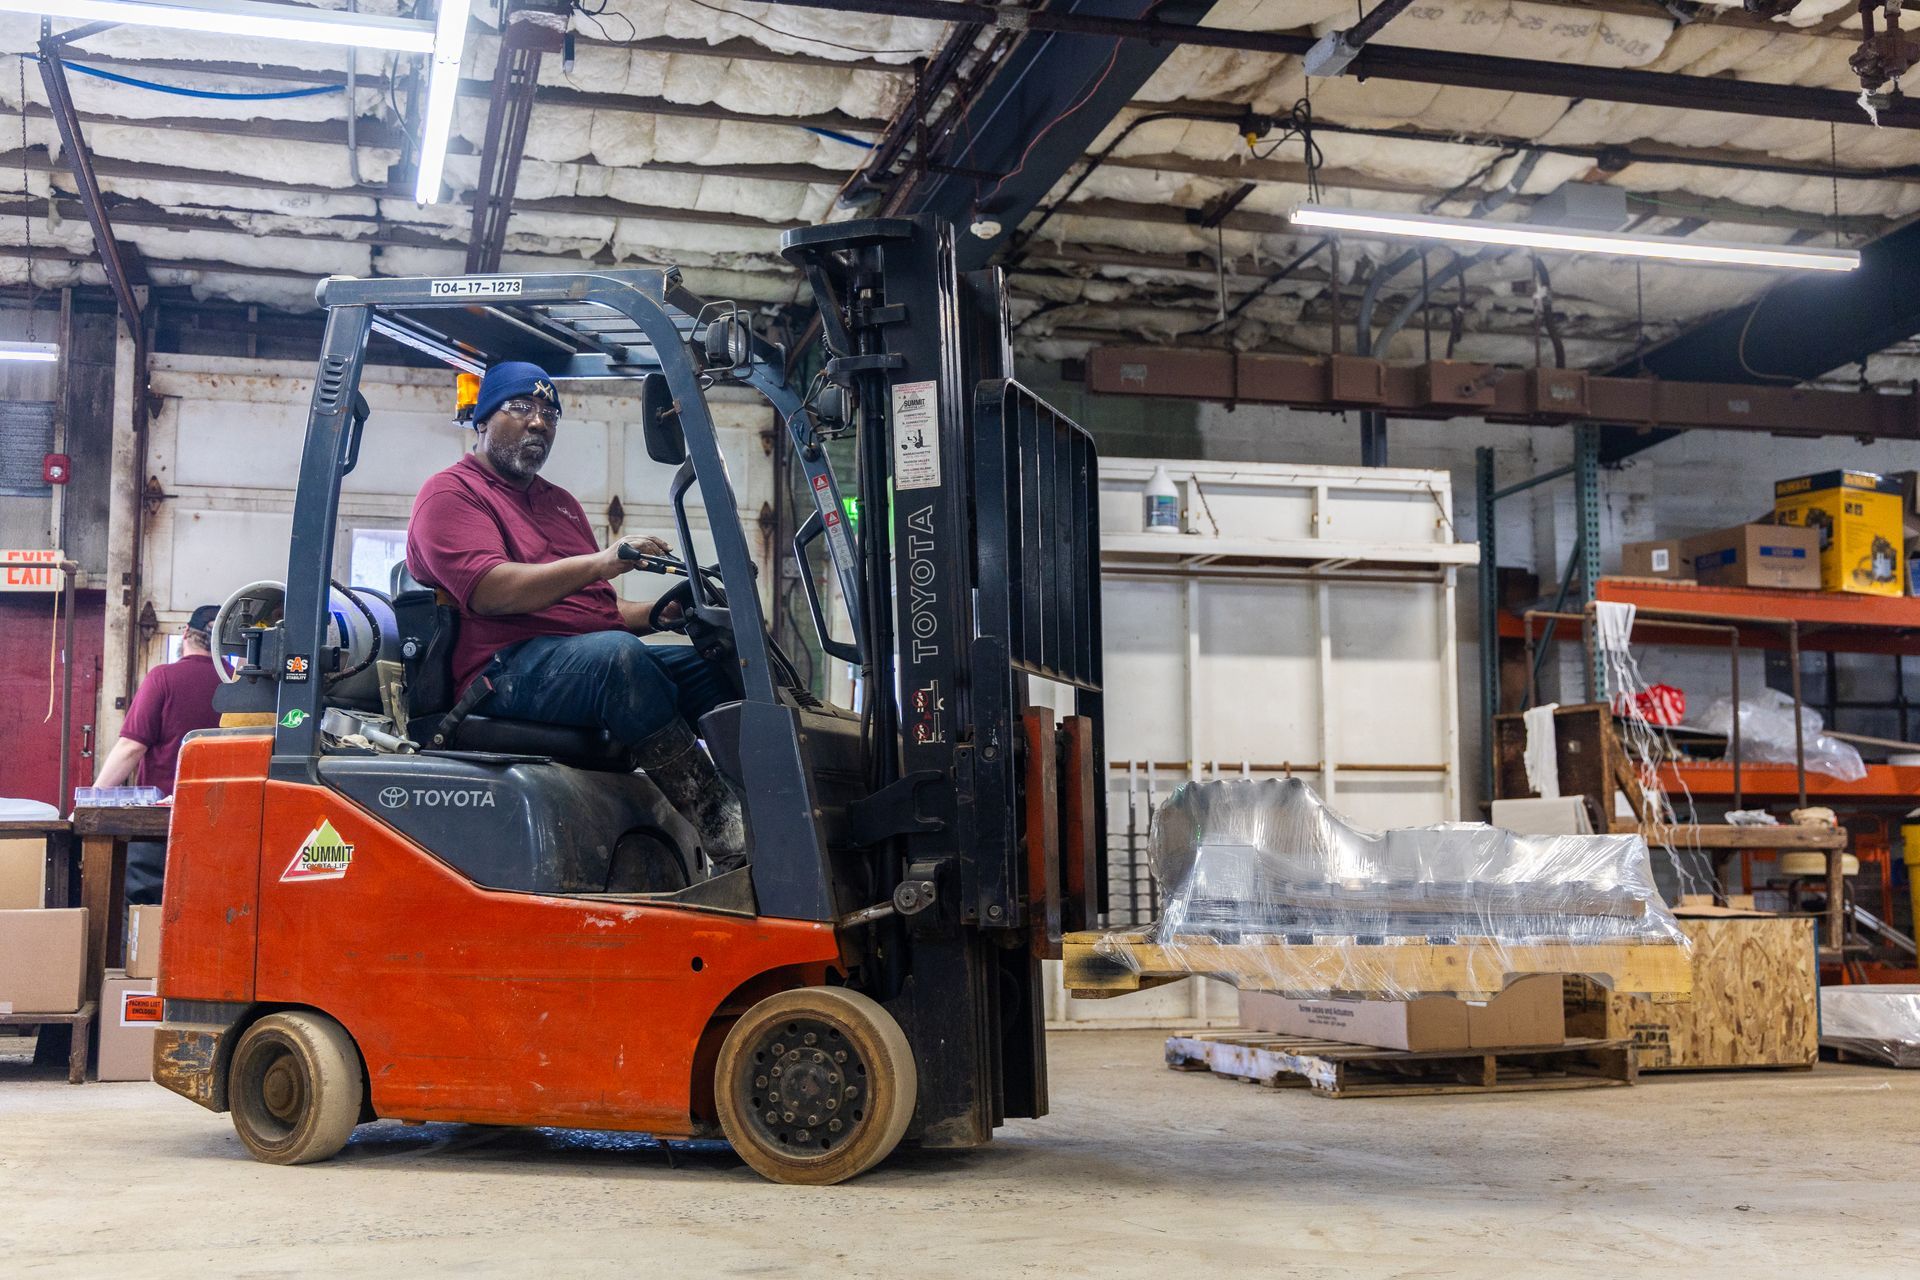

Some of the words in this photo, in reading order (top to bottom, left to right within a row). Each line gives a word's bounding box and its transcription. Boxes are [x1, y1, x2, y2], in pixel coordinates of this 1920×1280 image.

[904, 398, 926, 407] SUMMIT
[8, 551, 55, 585] EXIT
[908, 504, 938, 664] TOYOTA
[286, 656, 309, 672] SAS
[412, 789, 495, 807] TOYOTA
[302, 846, 354, 863] SUMMIT
